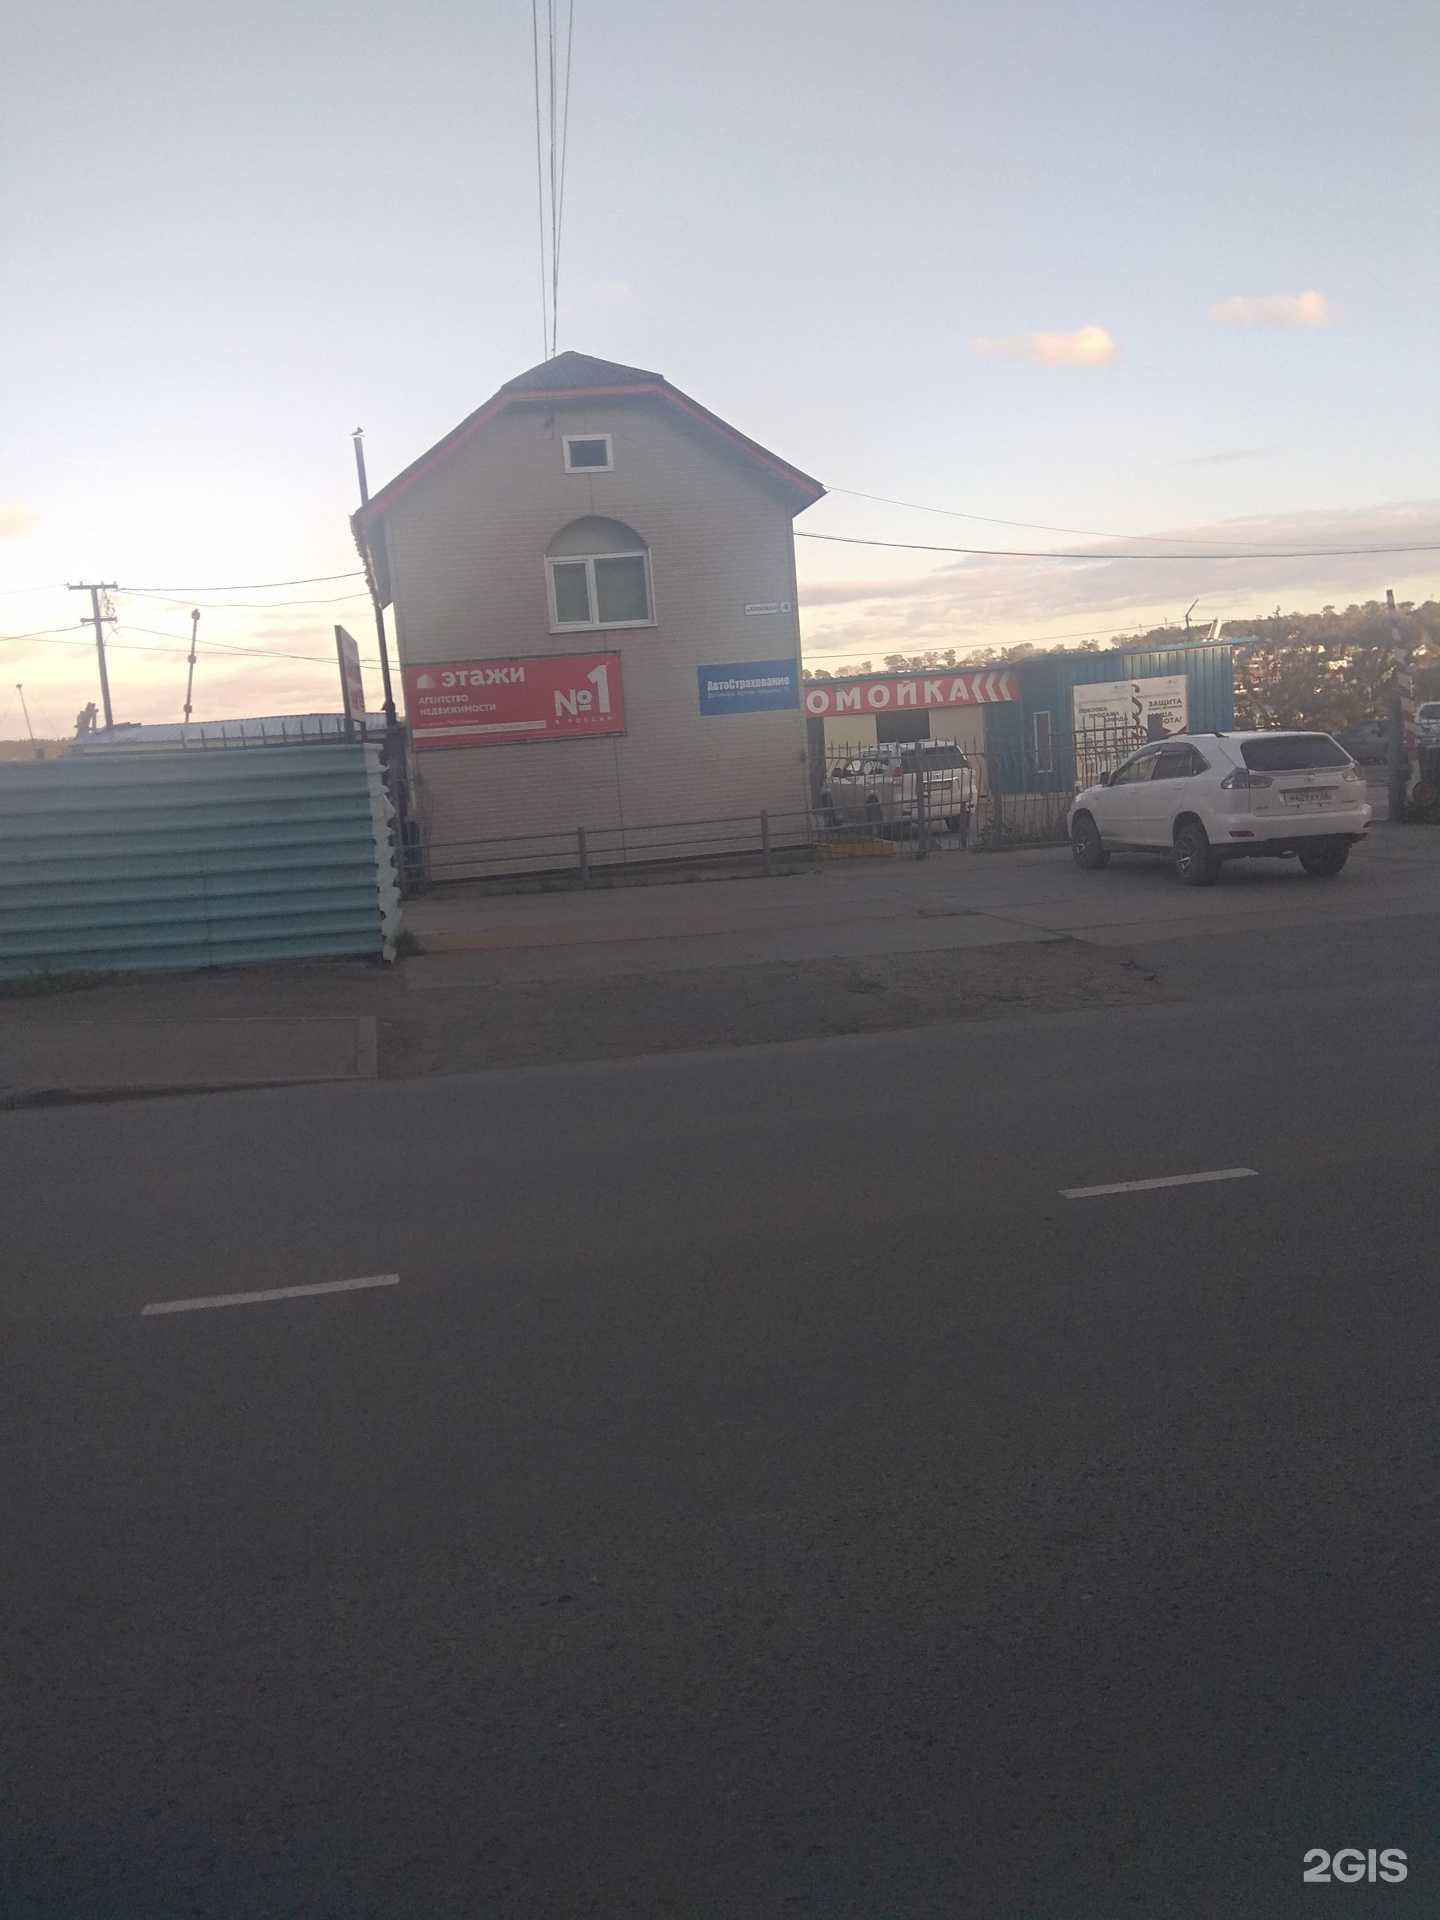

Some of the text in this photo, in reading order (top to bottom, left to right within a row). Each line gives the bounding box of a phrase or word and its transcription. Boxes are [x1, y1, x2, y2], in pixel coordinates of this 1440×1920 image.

[553, 664, 611, 717] №1
[707, 676, 790, 692] АвтоСтрахование
[418, 694, 469, 705] АГЕНТСТВО
[1148, 697, 1183, 707] ЗАЩИТА
[419, 703, 497, 716] НЕДВИЖИМОСТИ
